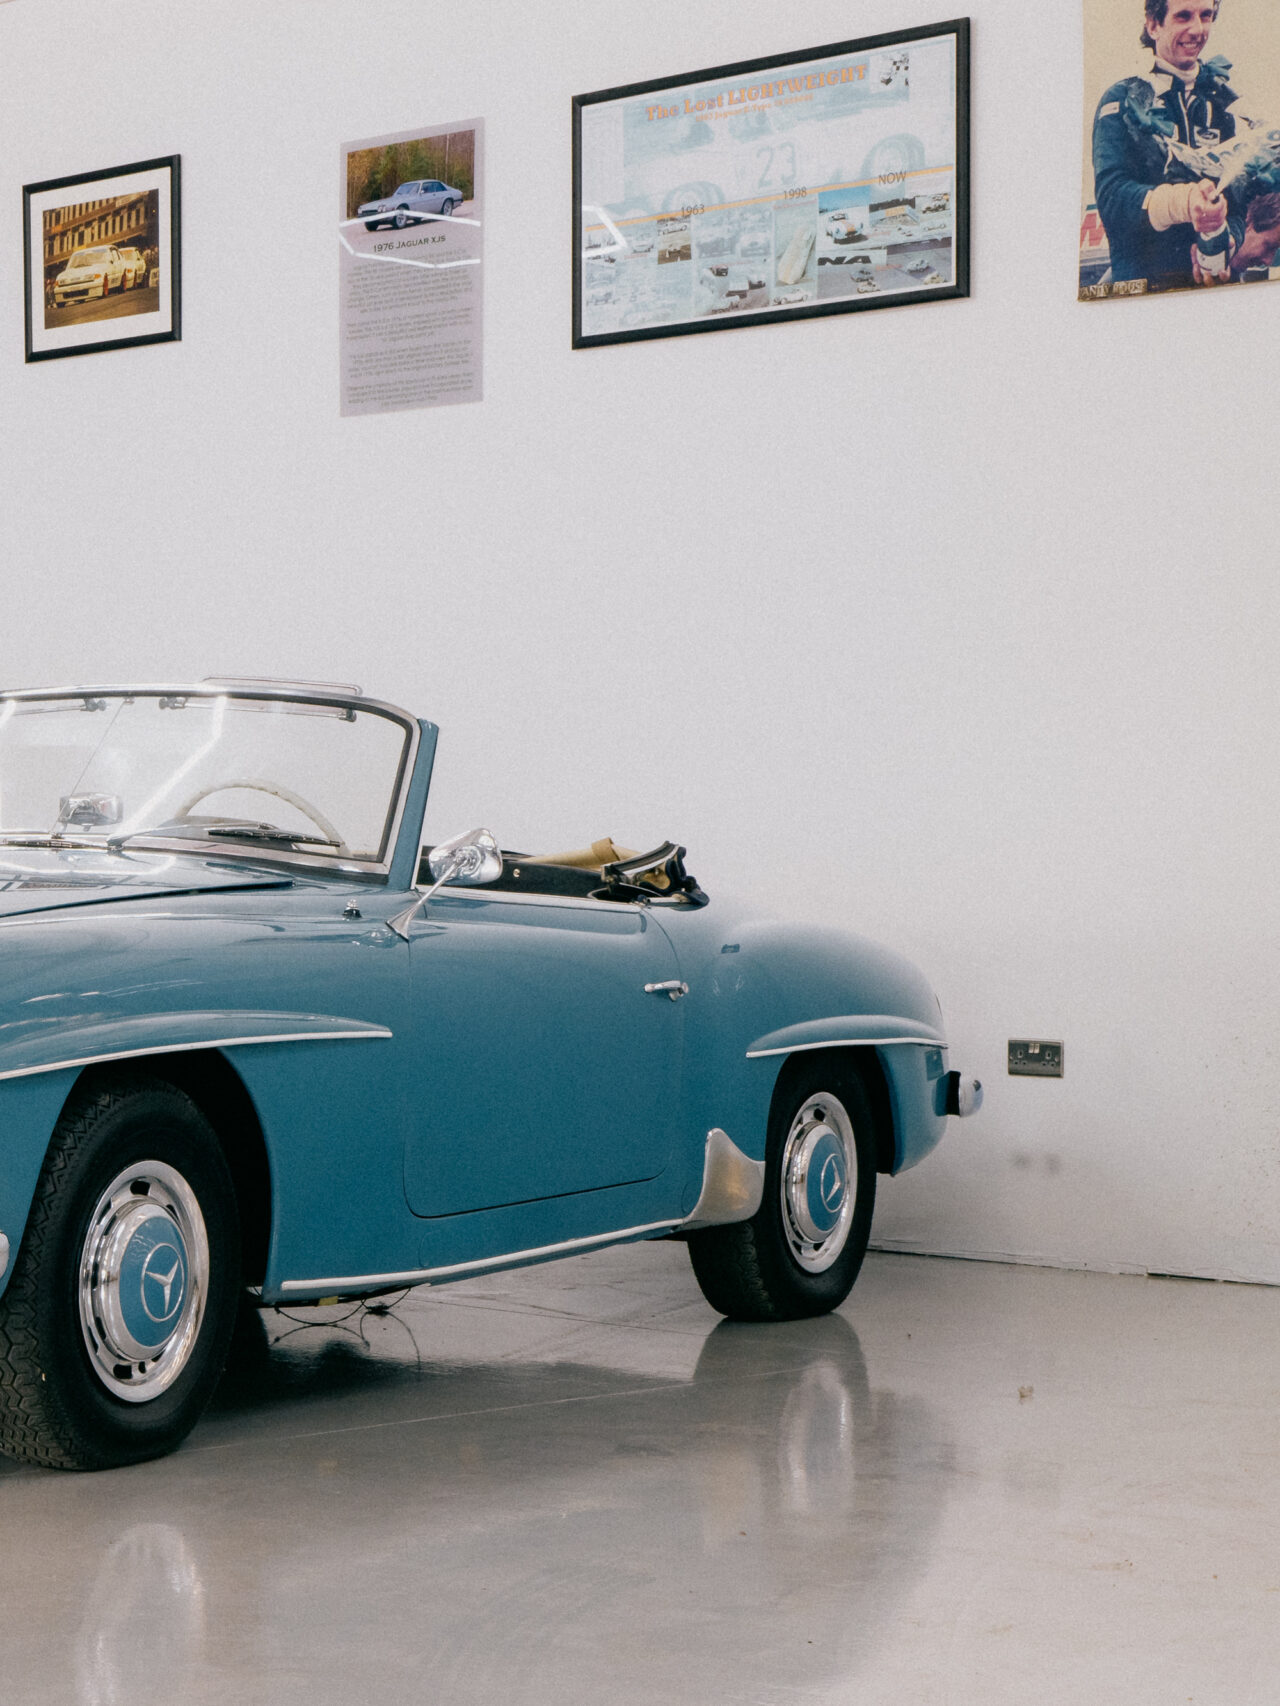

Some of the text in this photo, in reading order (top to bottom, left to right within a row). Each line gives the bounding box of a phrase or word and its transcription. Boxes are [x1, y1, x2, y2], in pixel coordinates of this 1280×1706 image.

[645, 105, 679, 121] The
[684, 95, 723, 114] Lost
[727, 64, 868, 105] LIGHTWEIGHT
[756, 141, 796, 188] 23
[878, 171, 907, 185] NOW
[783, 187, 807, 200] 1998
[681, 204, 705, 217] 1963
[373, 235, 446, 252] 1976 JAGUAR XJS
